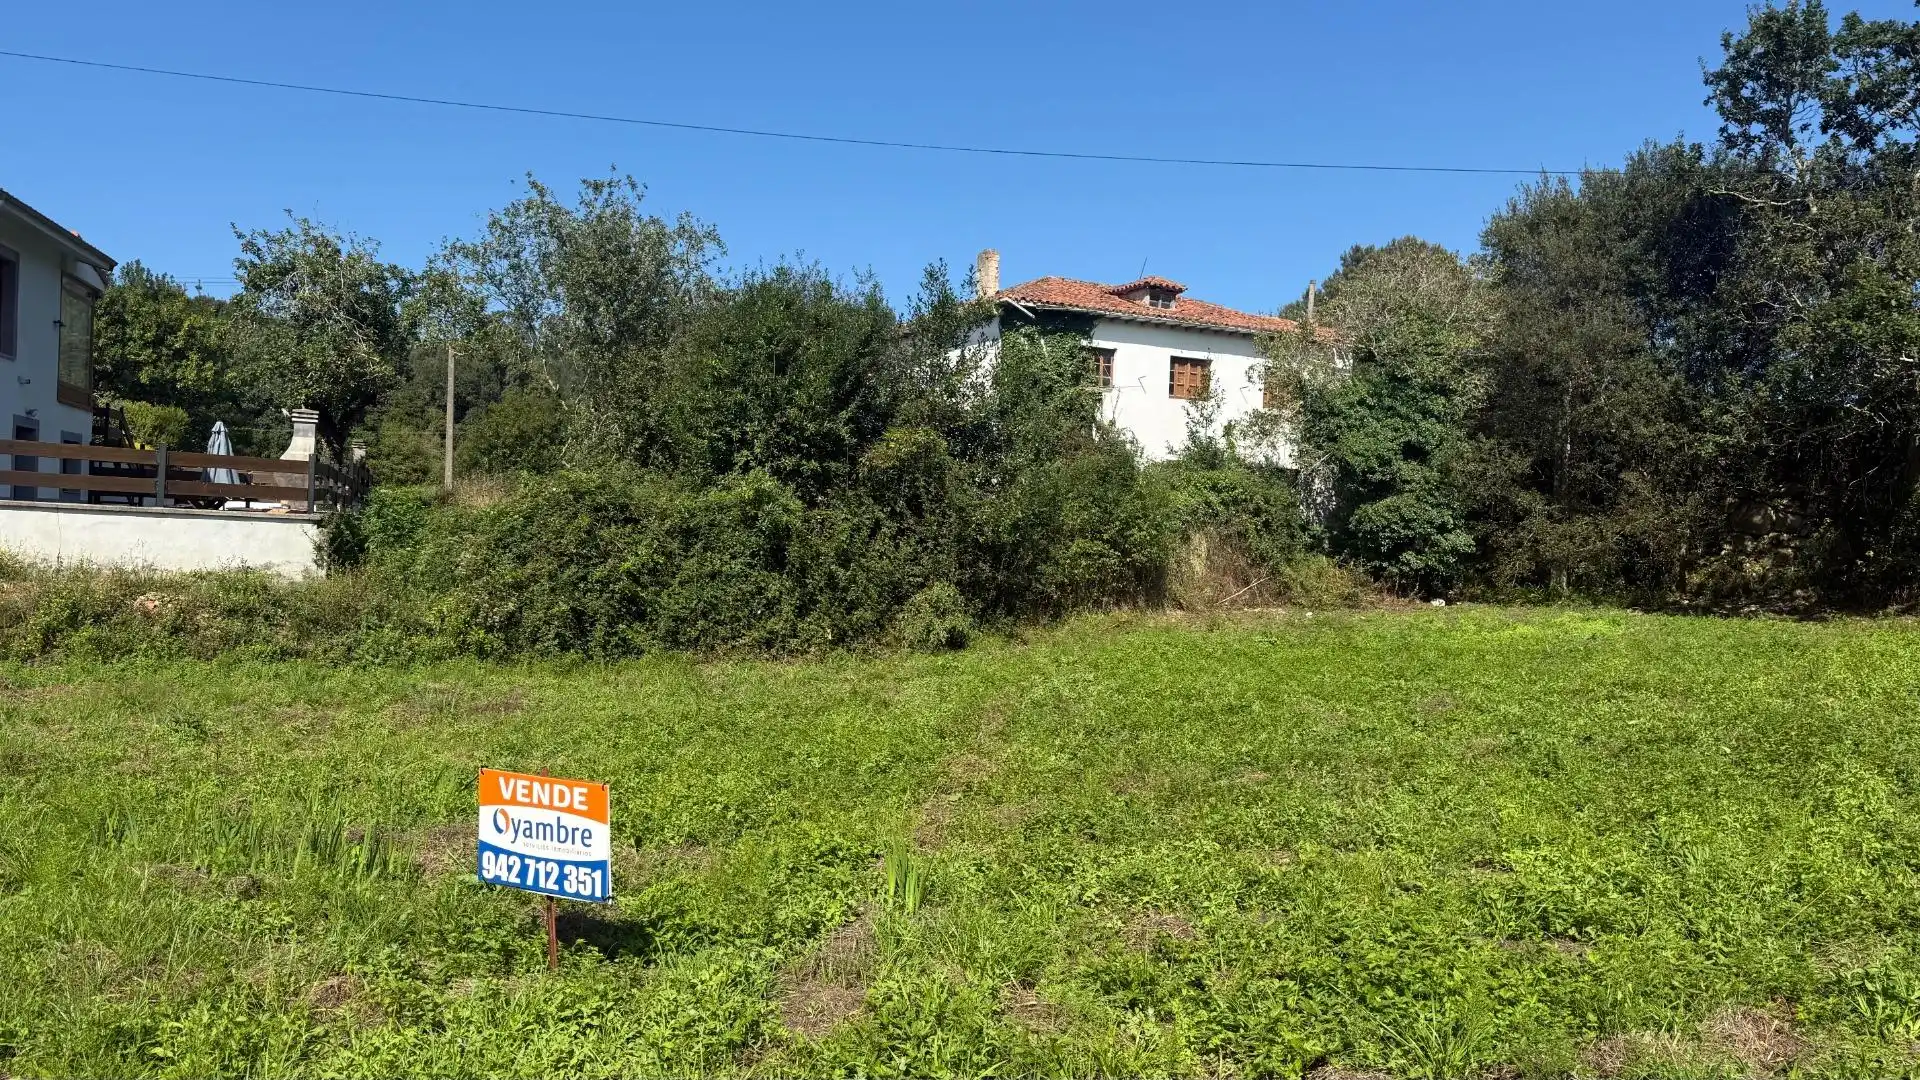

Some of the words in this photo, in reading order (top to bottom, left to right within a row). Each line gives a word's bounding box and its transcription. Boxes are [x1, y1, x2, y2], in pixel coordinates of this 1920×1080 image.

[499, 776, 588, 811] VENDE
[493, 807, 592, 848] Oyambre
[482, 851, 521, 884] 942
[524, 858, 559, 891] 712
[563, 864, 602, 898] 351
